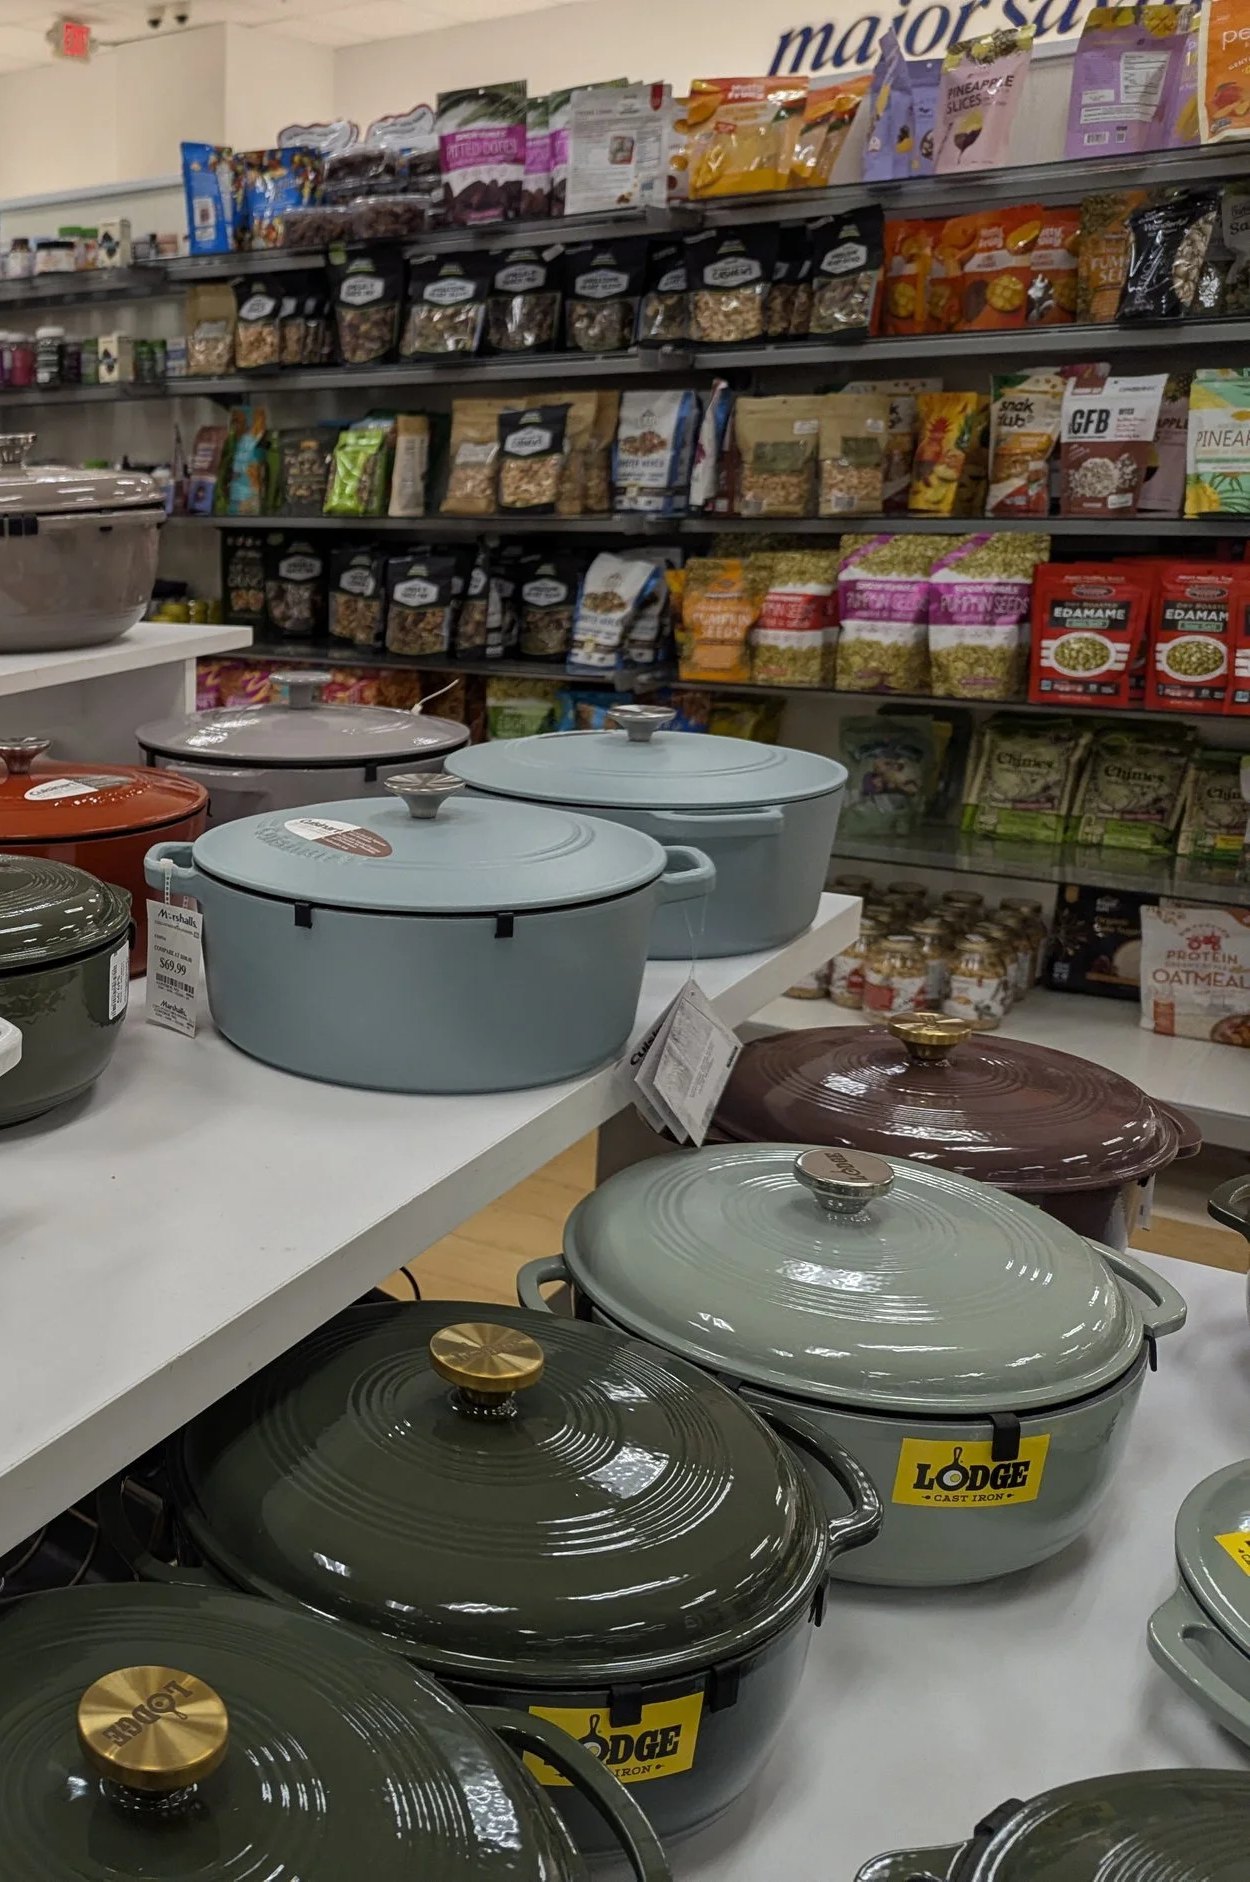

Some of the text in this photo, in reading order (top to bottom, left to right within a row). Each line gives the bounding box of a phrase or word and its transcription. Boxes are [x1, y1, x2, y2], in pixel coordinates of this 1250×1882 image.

[948, 75, 1014, 100] PINEAPPLE
[947, 94, 982, 114] SLICES
[1072, 408, 1110, 434] GFB
[1053, 607, 1126, 621] EDAMAME
[1104, 763, 1166, 783] Chimes
[159, 957, 187, 976] $69.99
[1166, 950, 1238, 965] PROTEIN
[1152, 968, 1250, 989] OATMEAL
[913, 1453, 1031, 1491] LODGE
[934, 1492, 1006, 1503] CAST IRON
[101, 1679, 194, 1747] LODGE
[576, 1718, 682, 1766] ODGE
[614, 1764, 652, 1778] IRON
